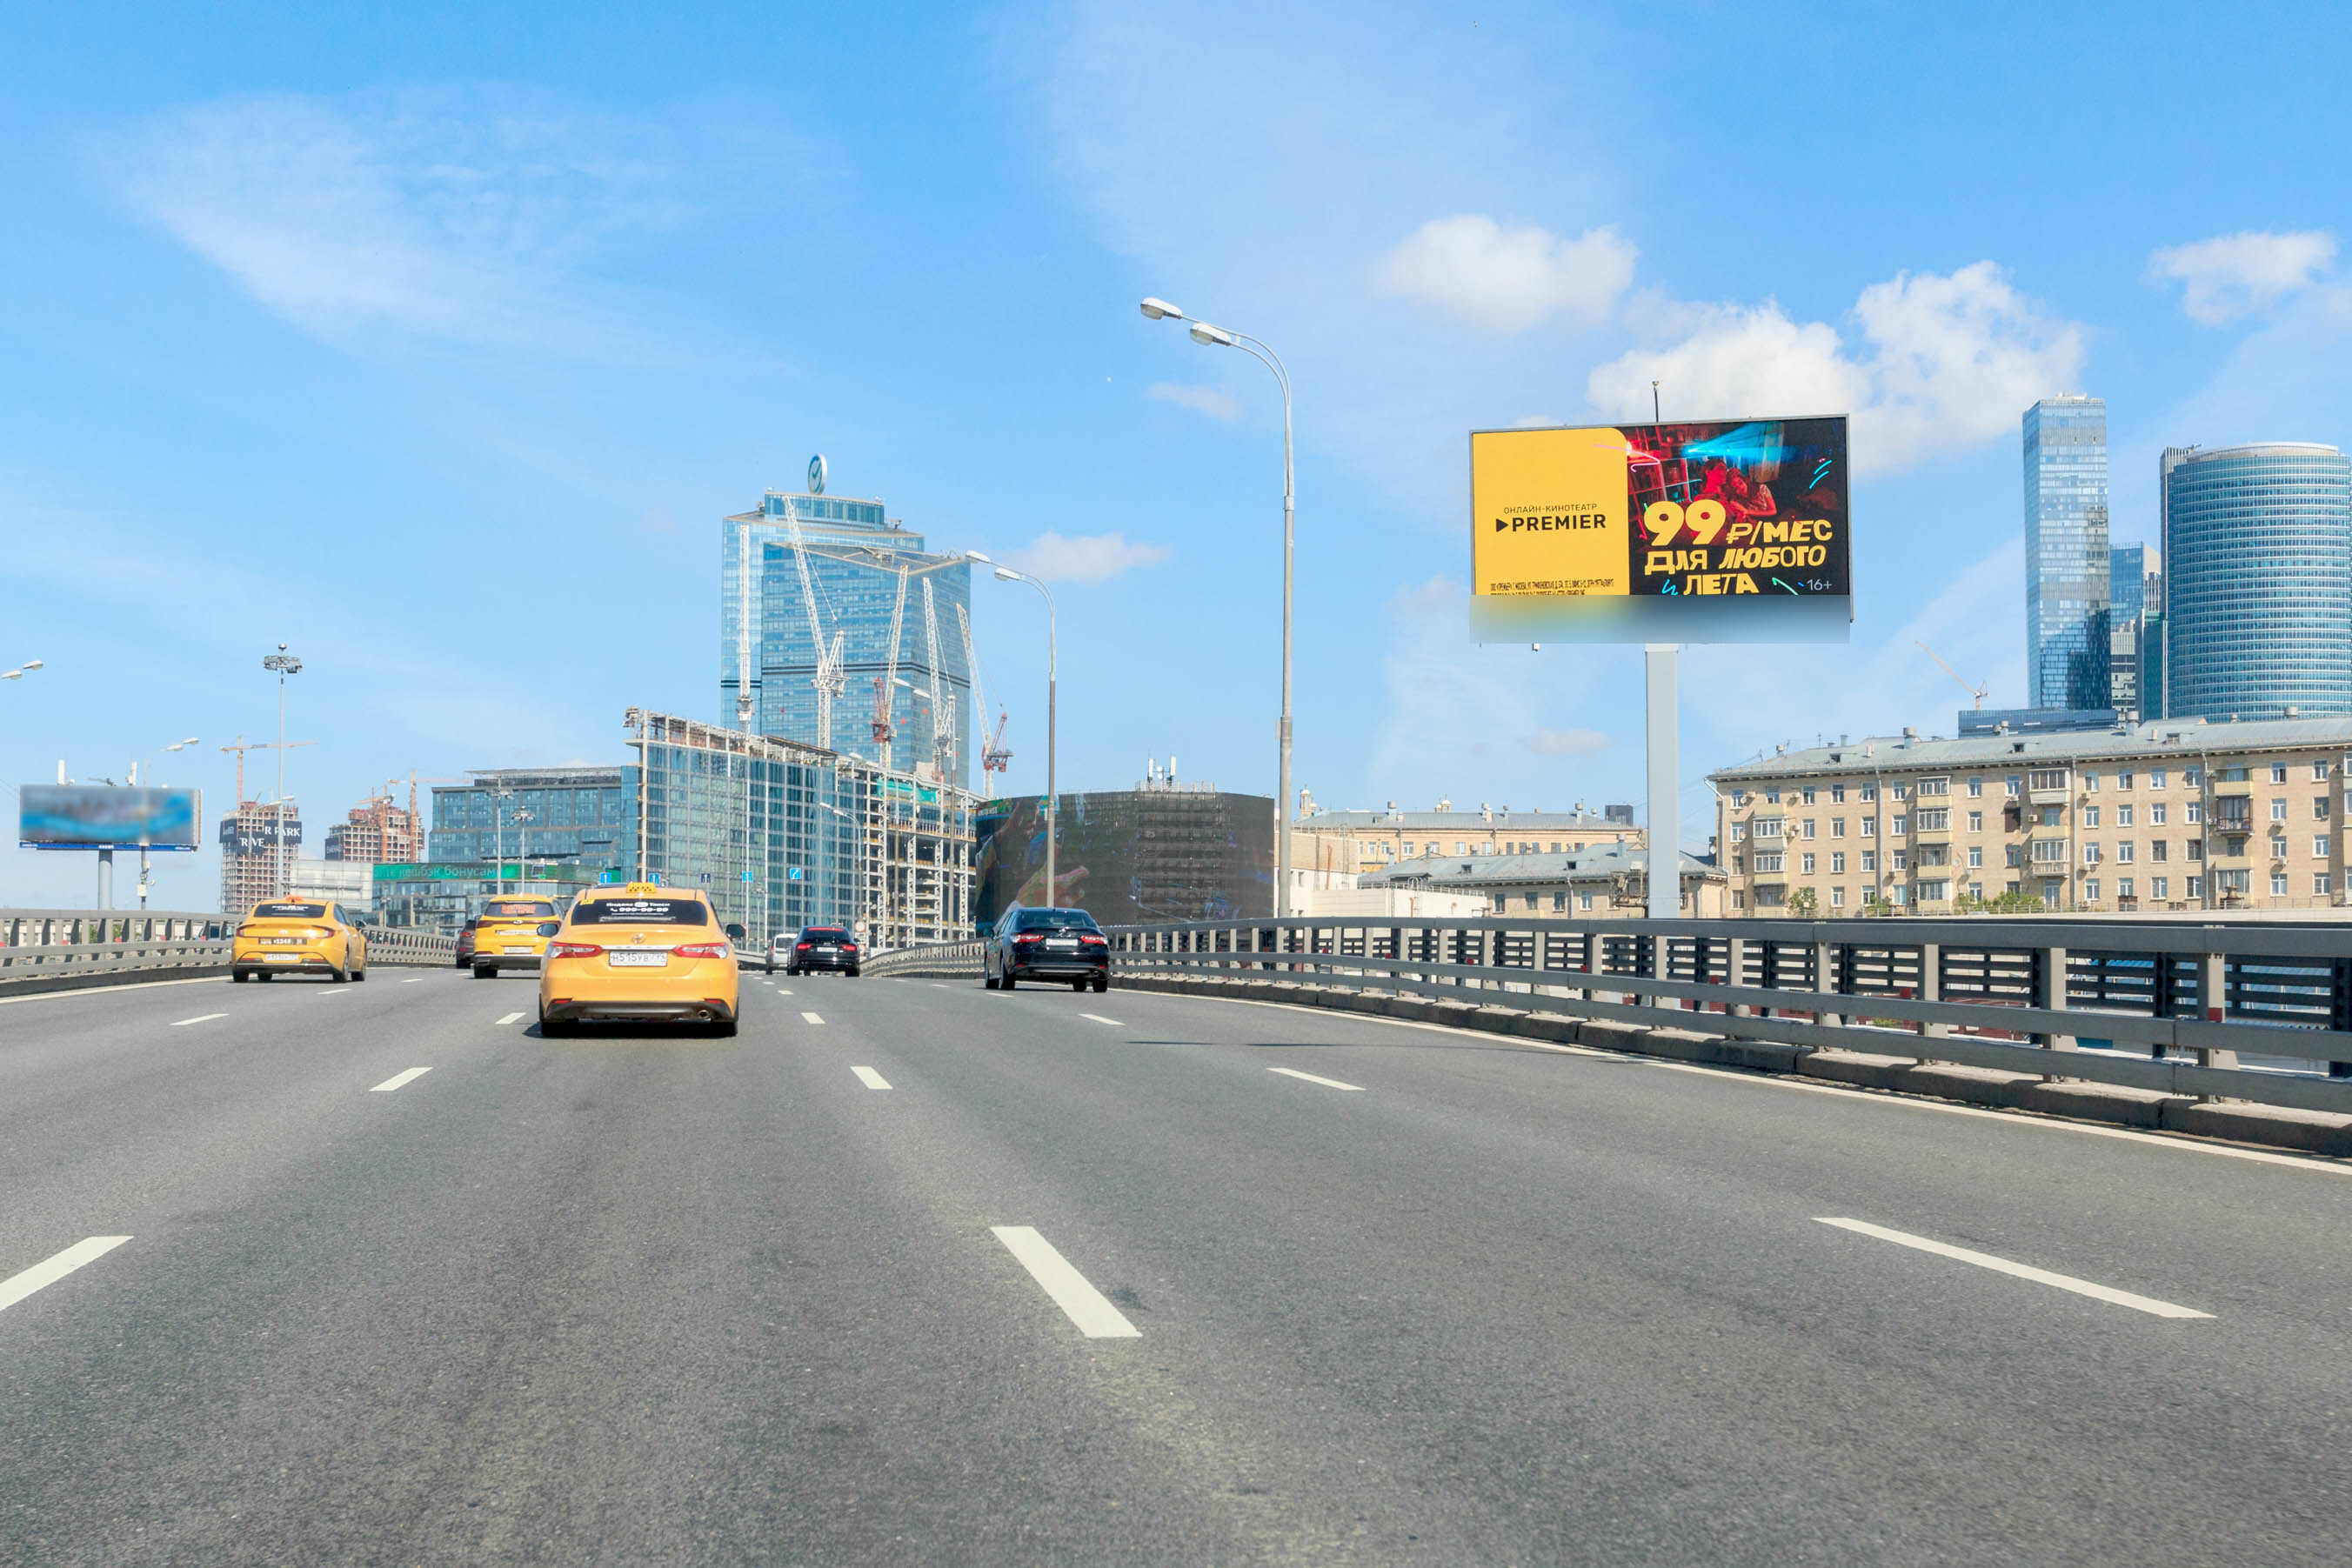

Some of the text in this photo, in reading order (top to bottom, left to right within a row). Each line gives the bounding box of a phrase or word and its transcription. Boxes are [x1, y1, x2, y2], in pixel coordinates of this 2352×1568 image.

[1503, 503, 1598, 515] ОНЛАЙН-КИНОТЕАТР
[1512, 514, 1607, 532] PREMIER
[1643, 498, 1727, 546] 99
[1644, 544, 1827, 576] ДЛЯ ЛЮБОГО
[1683, 572, 1760, 595] ЛЕТА
[1806, 578, 1833, 591] 16+
